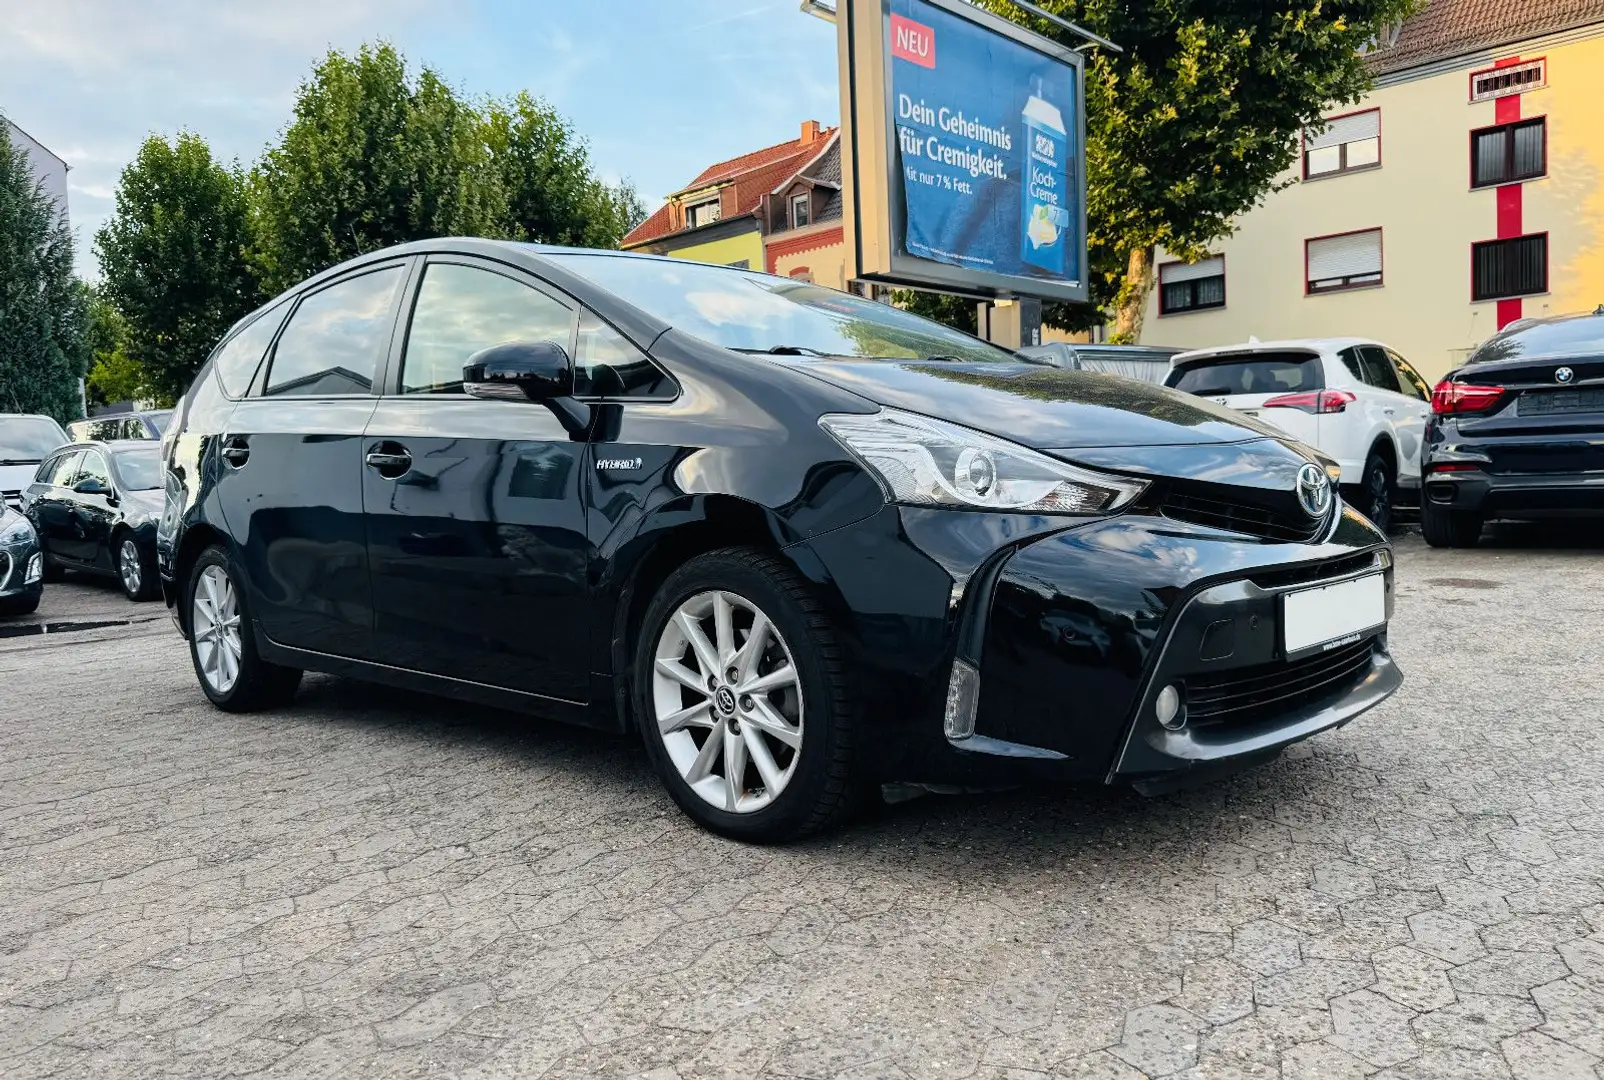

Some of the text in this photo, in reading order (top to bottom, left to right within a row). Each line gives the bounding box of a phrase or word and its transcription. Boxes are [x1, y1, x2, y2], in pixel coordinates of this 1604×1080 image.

[897, 25, 929, 58] NEU
[899, 93, 1012, 151] Dein Geheimnis
[899, 126, 924, 156] für
[926, 136, 1007, 180] Cremigkeit.
[919, 172, 934, 186] nur
[953, 178, 973, 195] Fett.
[1032, 166, 1057, 188] Koch-
[1030, 182, 1058, 205] Creme
